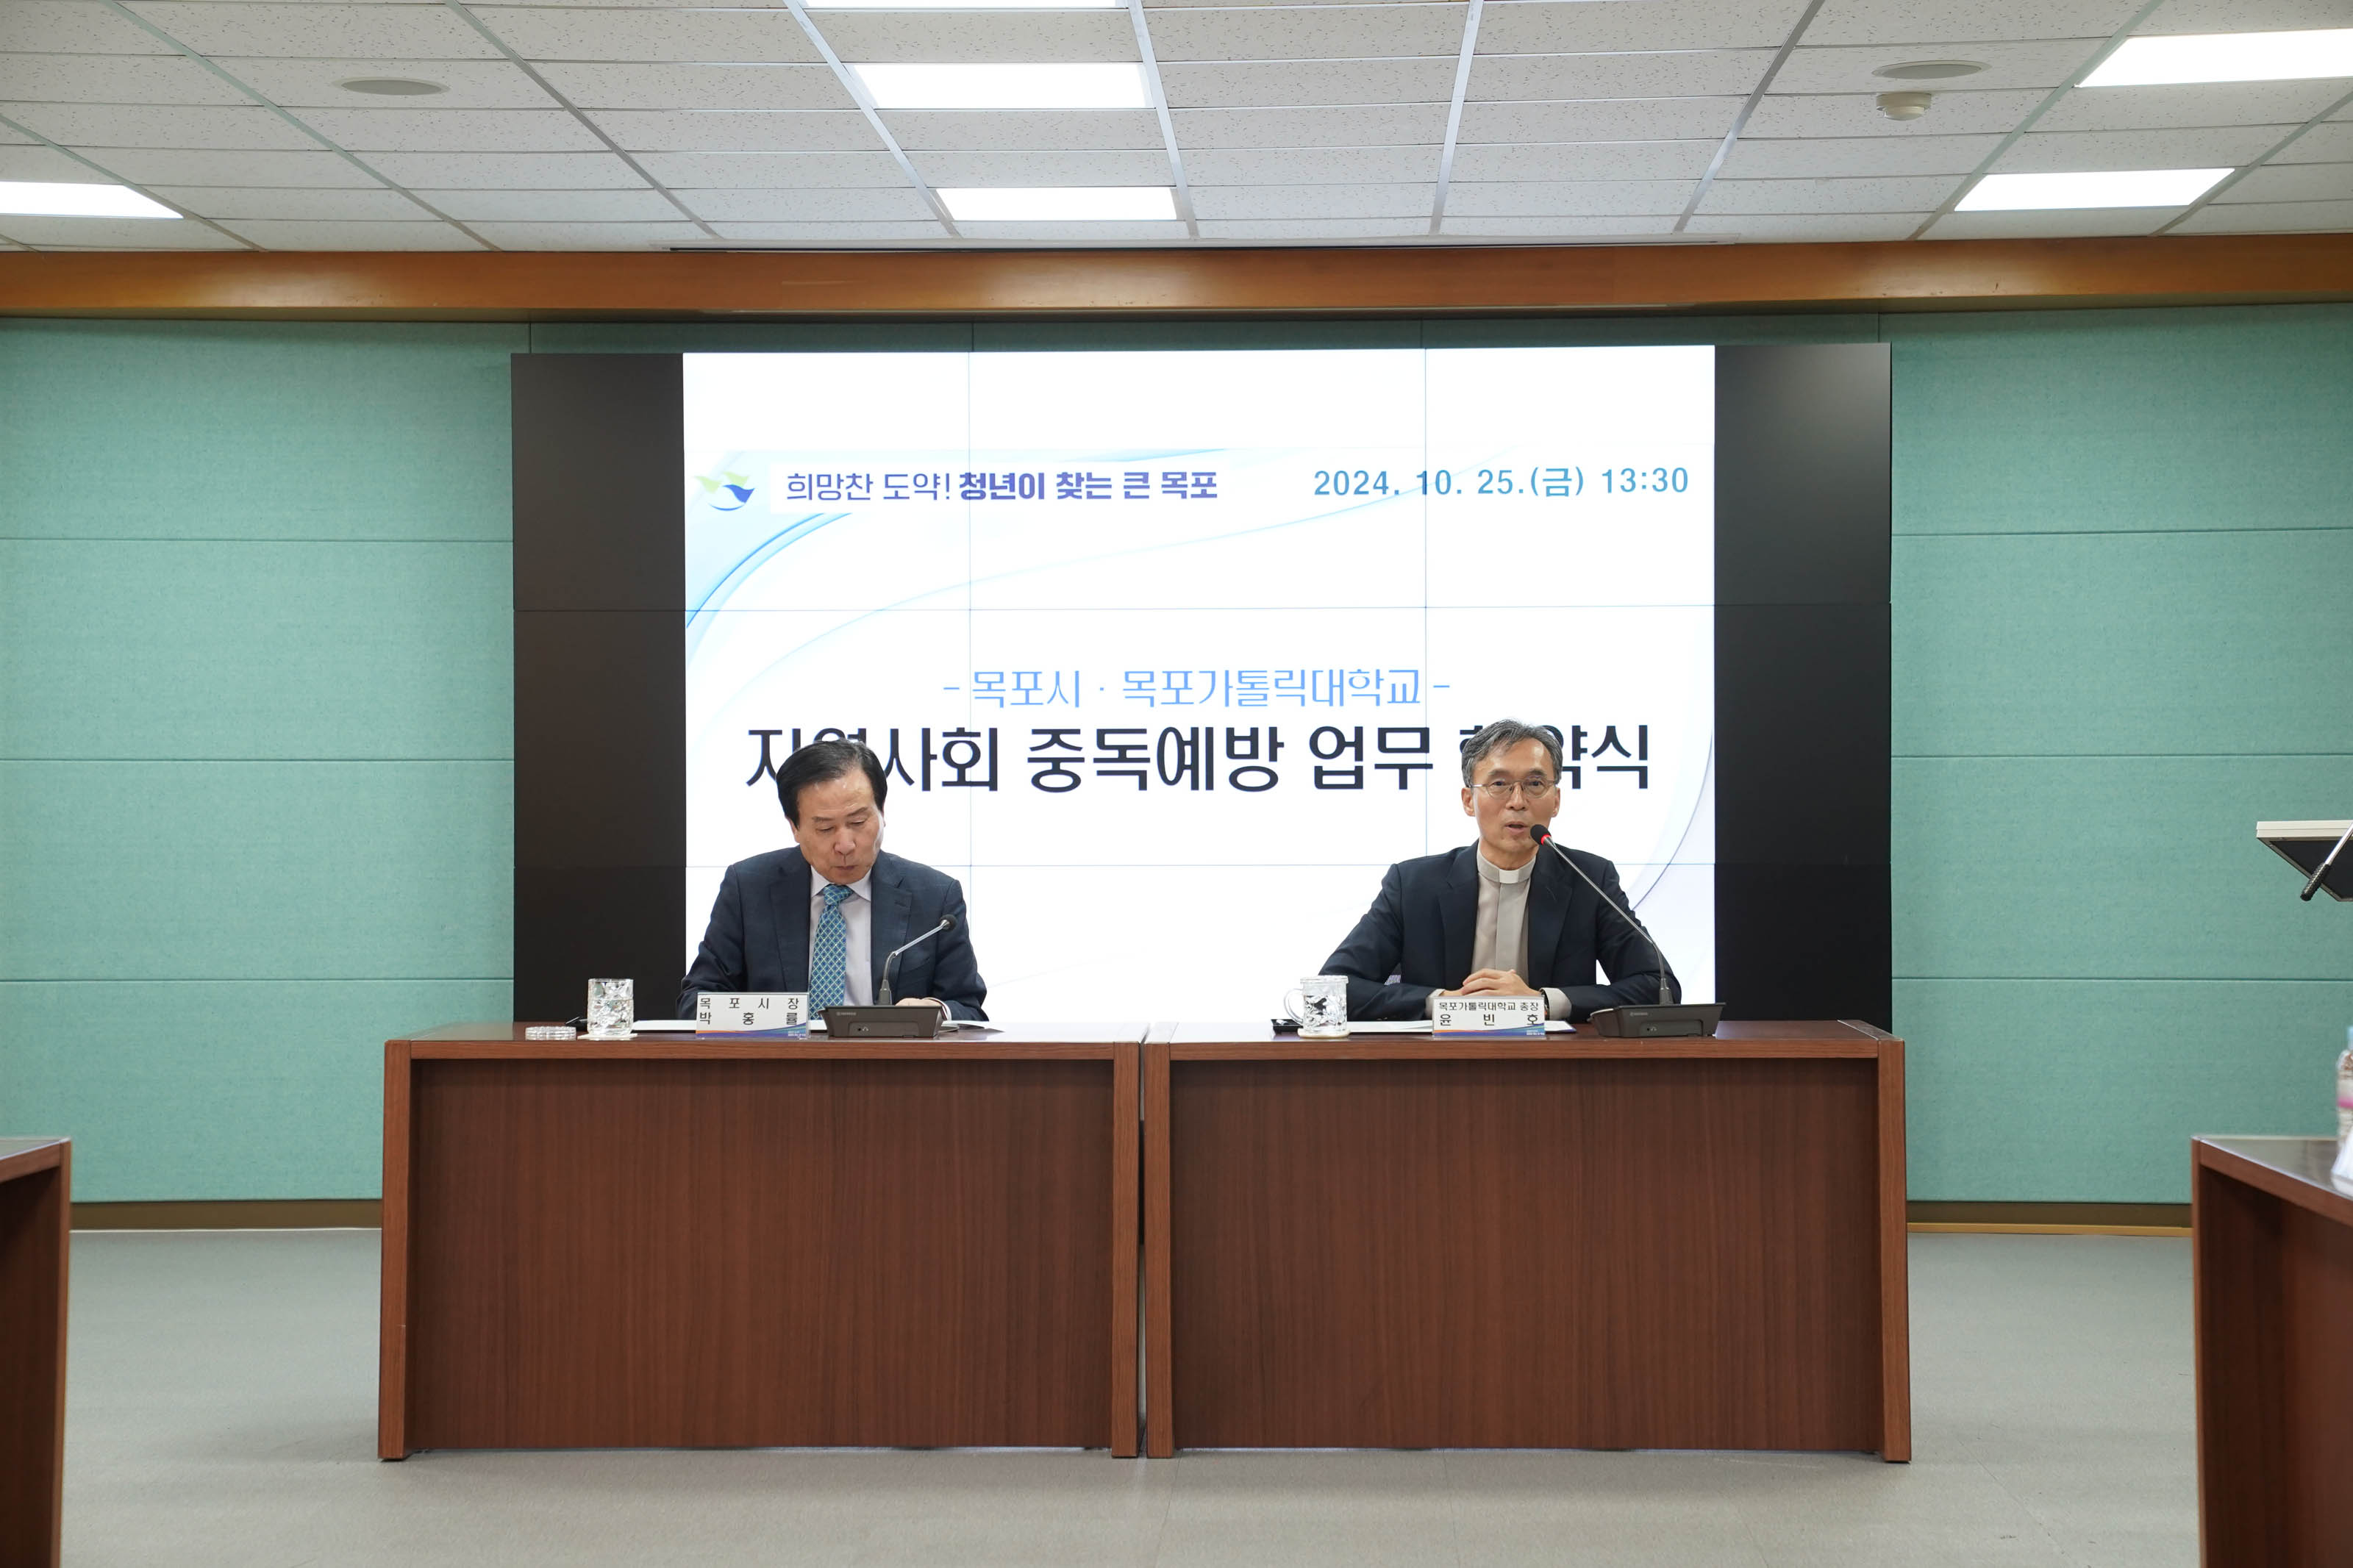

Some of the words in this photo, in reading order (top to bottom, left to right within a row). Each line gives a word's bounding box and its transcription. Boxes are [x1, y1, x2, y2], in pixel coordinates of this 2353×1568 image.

[787, 473, 874, 501] 희망찬
[883, 473, 950, 501] 도약!
[959, 472, 1045, 501] 청년이
[1056, 471, 1113, 500] 찾는
[1123, 472, 1150, 499] 큰
[1161, 471, 1218, 499] 목포
[1314, 470, 1400, 496] 2024.
[1416, 470, 1462, 496] 10.
[1602, 467, 1688, 494] 13:30
[972, 670, 1079, 709] 목포시
[1123, 668, 1421, 708] 목포가톨릭대학교
[746, 726, 998, 792] 지사회
[1027, 726, 1285, 793] 중독예방
[1309, 726, 1433, 790] 업무
[1460, 724, 1648, 790] 약식
[1439, 1002, 1515, 1012] 목포가톨릭대학교
[1520, 1002, 1539, 1012] 총장
